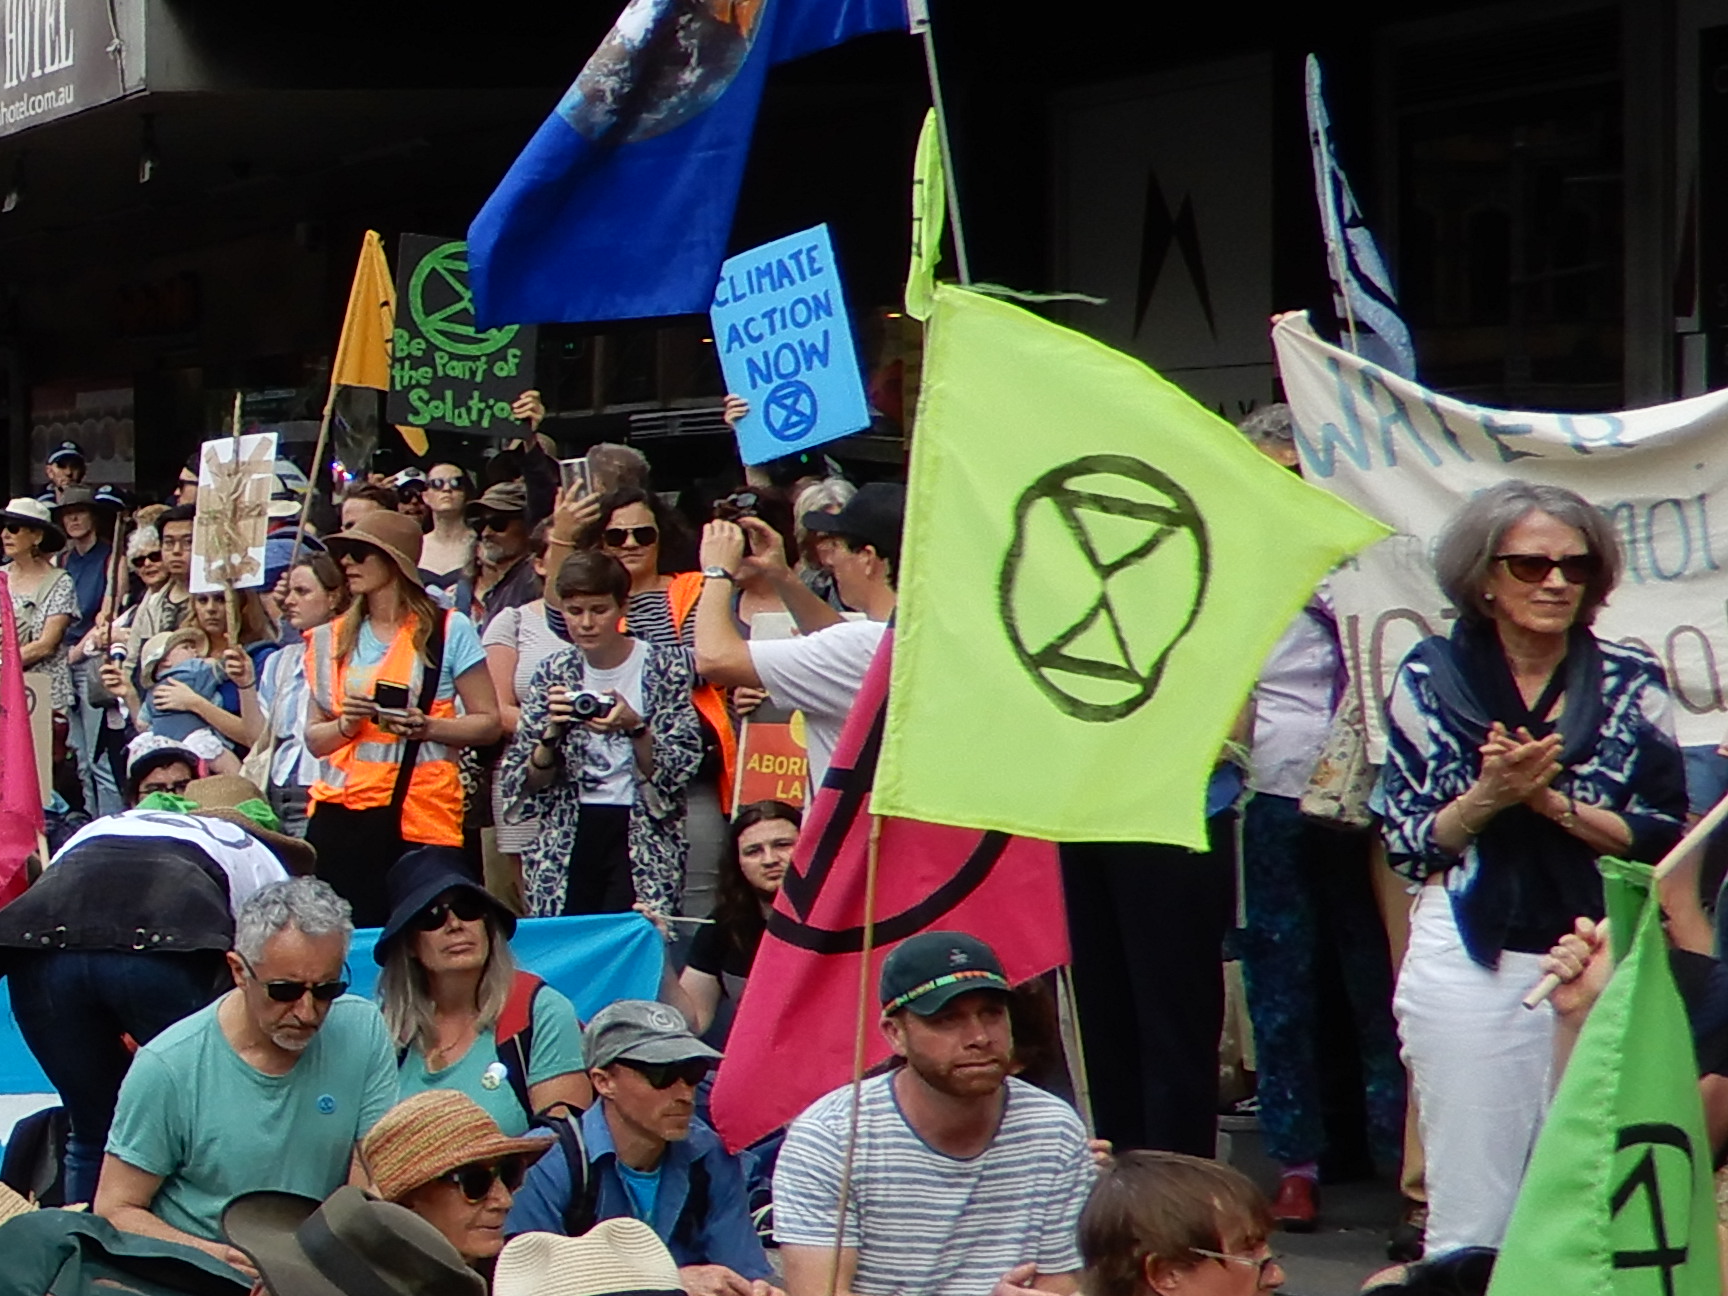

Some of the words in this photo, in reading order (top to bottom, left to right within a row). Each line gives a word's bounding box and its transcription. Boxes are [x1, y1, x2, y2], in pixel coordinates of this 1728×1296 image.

[713, 243, 825, 308] CLIMATE
[725, 289, 834, 355] ACTION
[394, 328, 427, 358] Be
[392, 359, 434, 391] the
[434, 351, 488, 383] Part
[745, 329, 831, 391] NOW
[407, 387, 522, 429] Solutio
[746, 752, 808, 777] ABORI
[776, 779, 804, 800] LA
